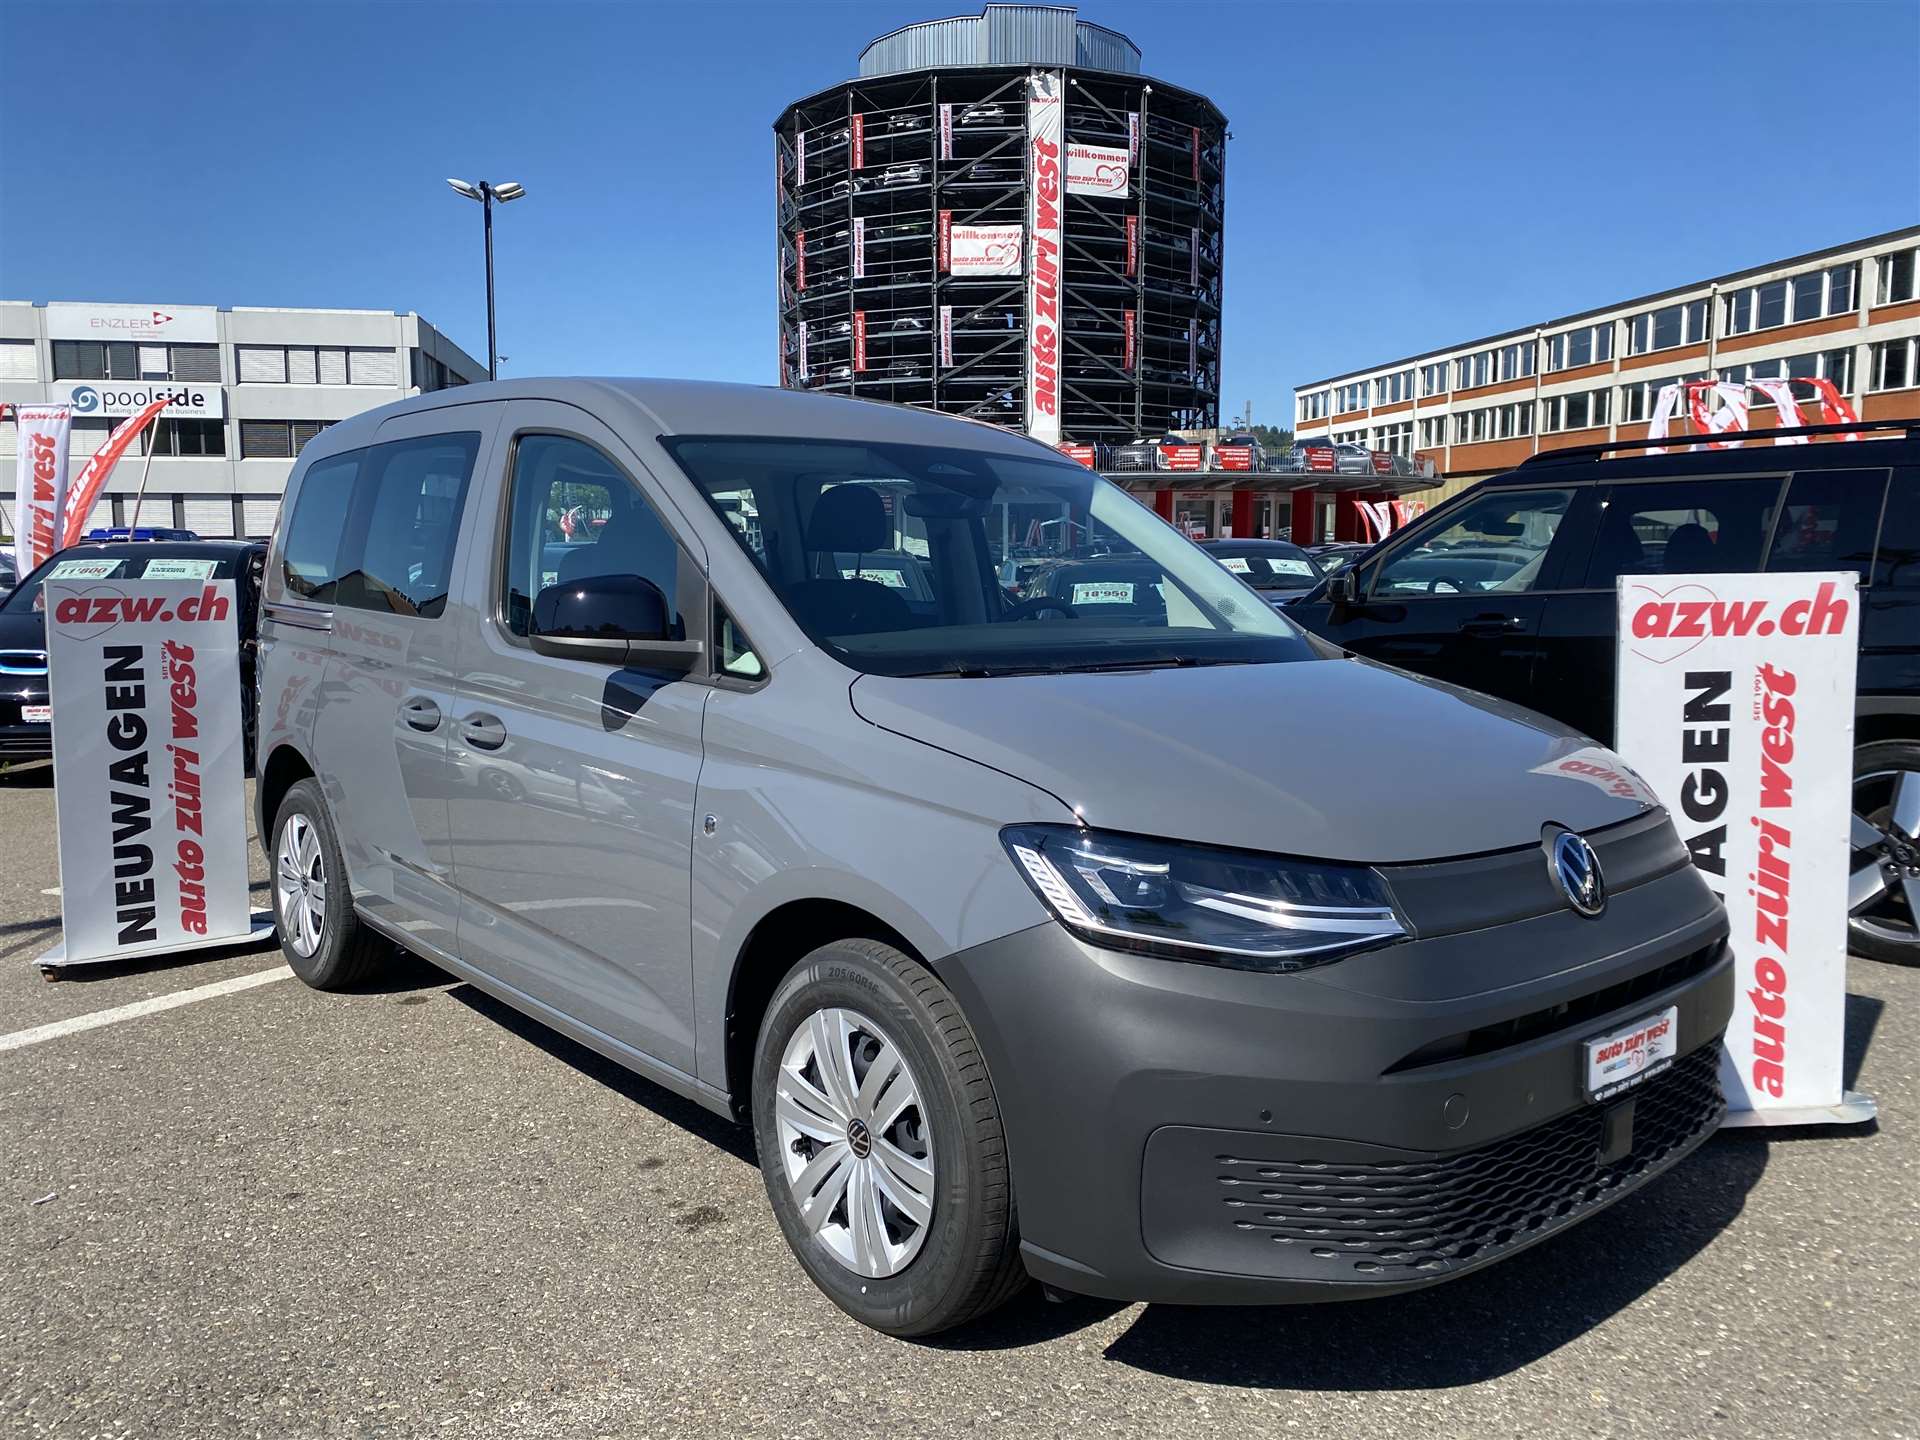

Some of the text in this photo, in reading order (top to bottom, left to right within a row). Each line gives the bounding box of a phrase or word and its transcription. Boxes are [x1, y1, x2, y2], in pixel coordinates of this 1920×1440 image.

[1066, 149, 1128, 162] willkommen
[1031, 136, 1060, 416] auto züri west
[90, 318, 151, 329] ENZLER
[102, 387, 205, 413] poolside
[32, 432, 56, 502] west
[55, 585, 229, 624] azw.ch
[1632, 582, 1849, 639] azw.ch
[1753, 702, 1761, 721] SEIT
[103, 645, 157, 946] NEUWAGEN
[161, 640, 208, 936] auto züri west
[1681, 671, 1733, 904] AGEN
[1746, 661, 1797, 1099] auto züri west
[828, 967, 880, 994] 205/60R16
